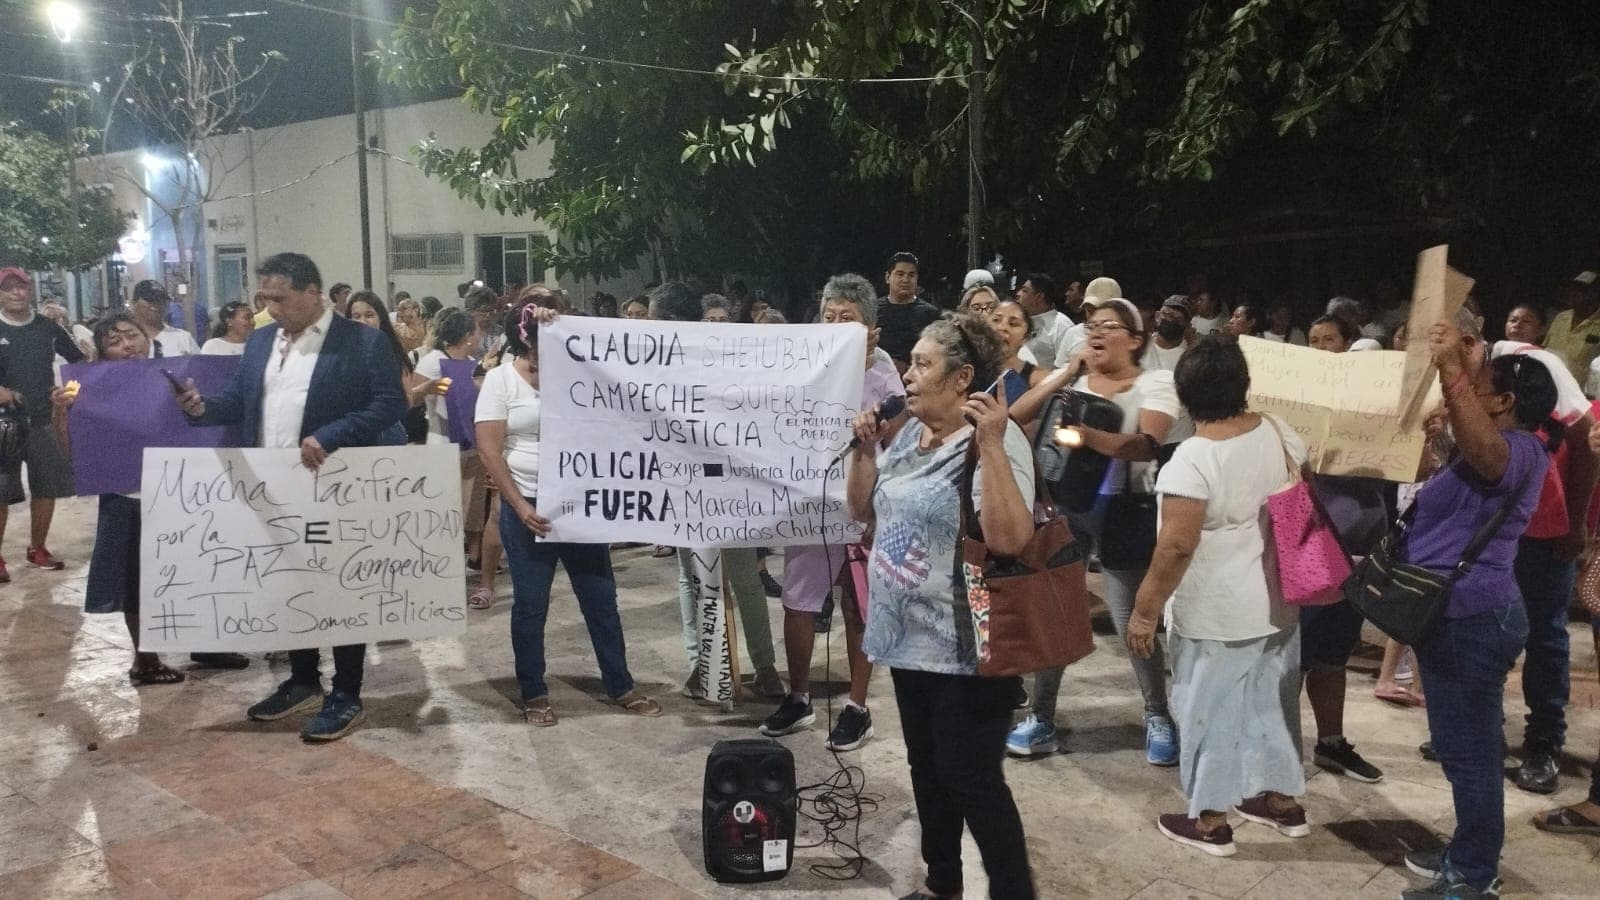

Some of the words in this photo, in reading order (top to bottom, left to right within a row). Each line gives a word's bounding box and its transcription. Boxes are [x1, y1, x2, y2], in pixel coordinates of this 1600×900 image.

[565, 332, 686, 366] CLAUDIA
[570, 379, 707, 414] CAMPECHE
[721, 383, 815, 414] QUIERE
[643, 417, 762, 448] JUSTICIA
[786, 418, 800, 427] EL
[803, 416, 841, 428] POLICIA
[801, 428, 840, 442] PUEBLO
[559, 450, 662, 481] POLICIA
[722, 454, 784, 482] Justicia
[790, 455, 845, 481] laboral
[148, 458, 289, 514] Marcha
[292, 456, 443, 507] Pacifica
[584, 487, 677, 522] FUERA
[685, 488, 765, 519] Marcela
[156, 524, 197, 559] por
[200, 509, 228, 551] la
[244, 509, 462, 553] SEGURIDAD
[686, 519, 774, 542] Mandos
[154, 564, 194, 598] y
[199, 547, 322, 588] PAZ
[307, 546, 335, 571] de
[339, 545, 460, 594] Campeche
[359, 589, 466, 626] Policias
[703, 595, 718, 635] MUJER
